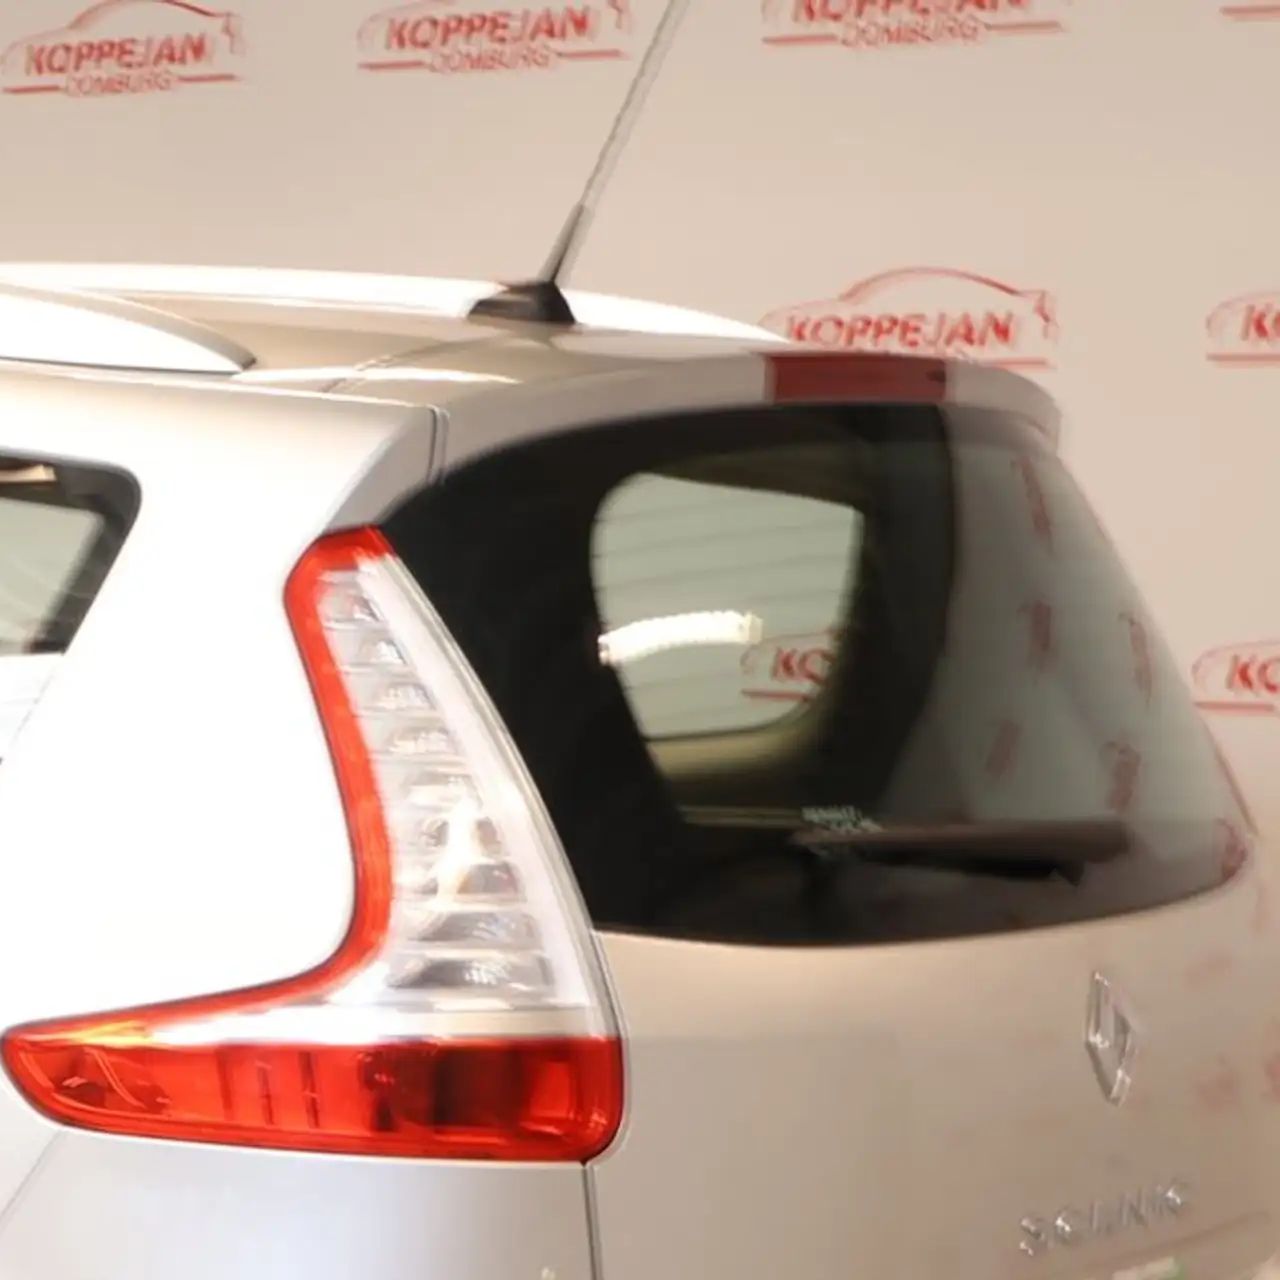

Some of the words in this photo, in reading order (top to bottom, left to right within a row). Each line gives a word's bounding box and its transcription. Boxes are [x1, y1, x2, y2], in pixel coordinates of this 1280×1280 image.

[384, 6, 591, 50] KOPPEJAN
[25, 33, 207, 75] KOPPEJAN
[786, 311, 1015, 347] KOPPEJAN
